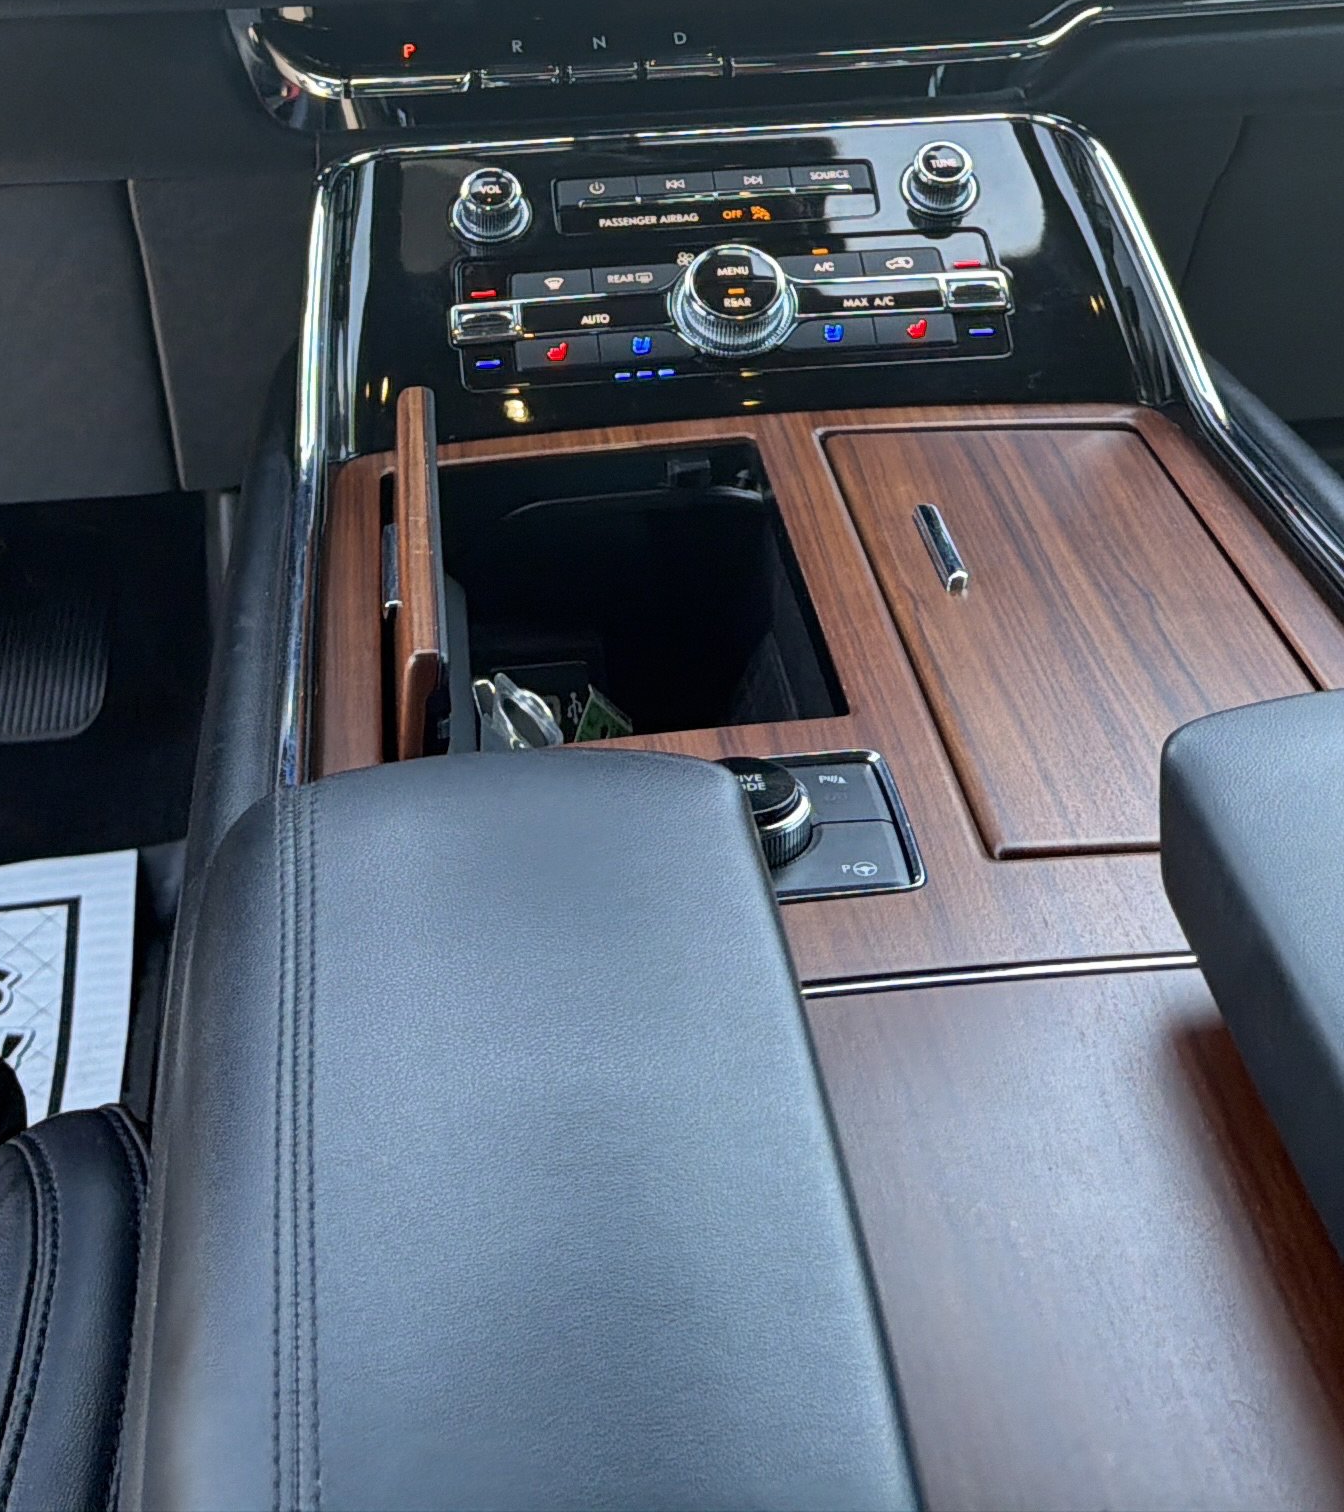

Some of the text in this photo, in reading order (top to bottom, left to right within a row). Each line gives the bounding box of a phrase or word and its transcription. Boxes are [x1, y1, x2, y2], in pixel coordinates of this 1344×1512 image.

[403, 32, 687, 58] P R N D
[930, 158, 957, 168] TUNE
[809, 169, 849, 181] SOURCE
[479, 184, 502, 194] VOL
[599, 209, 743, 228] PASSENGER AIRBAG OFF
[717, 265, 749, 276] MENU
[813, 261, 834, 272] A/C
[607, 272, 634, 284] REAR
[723, 297, 751, 307] REAR
[843, 295, 895, 308] MAX A/C
[580, 314, 610, 326] AUTO
